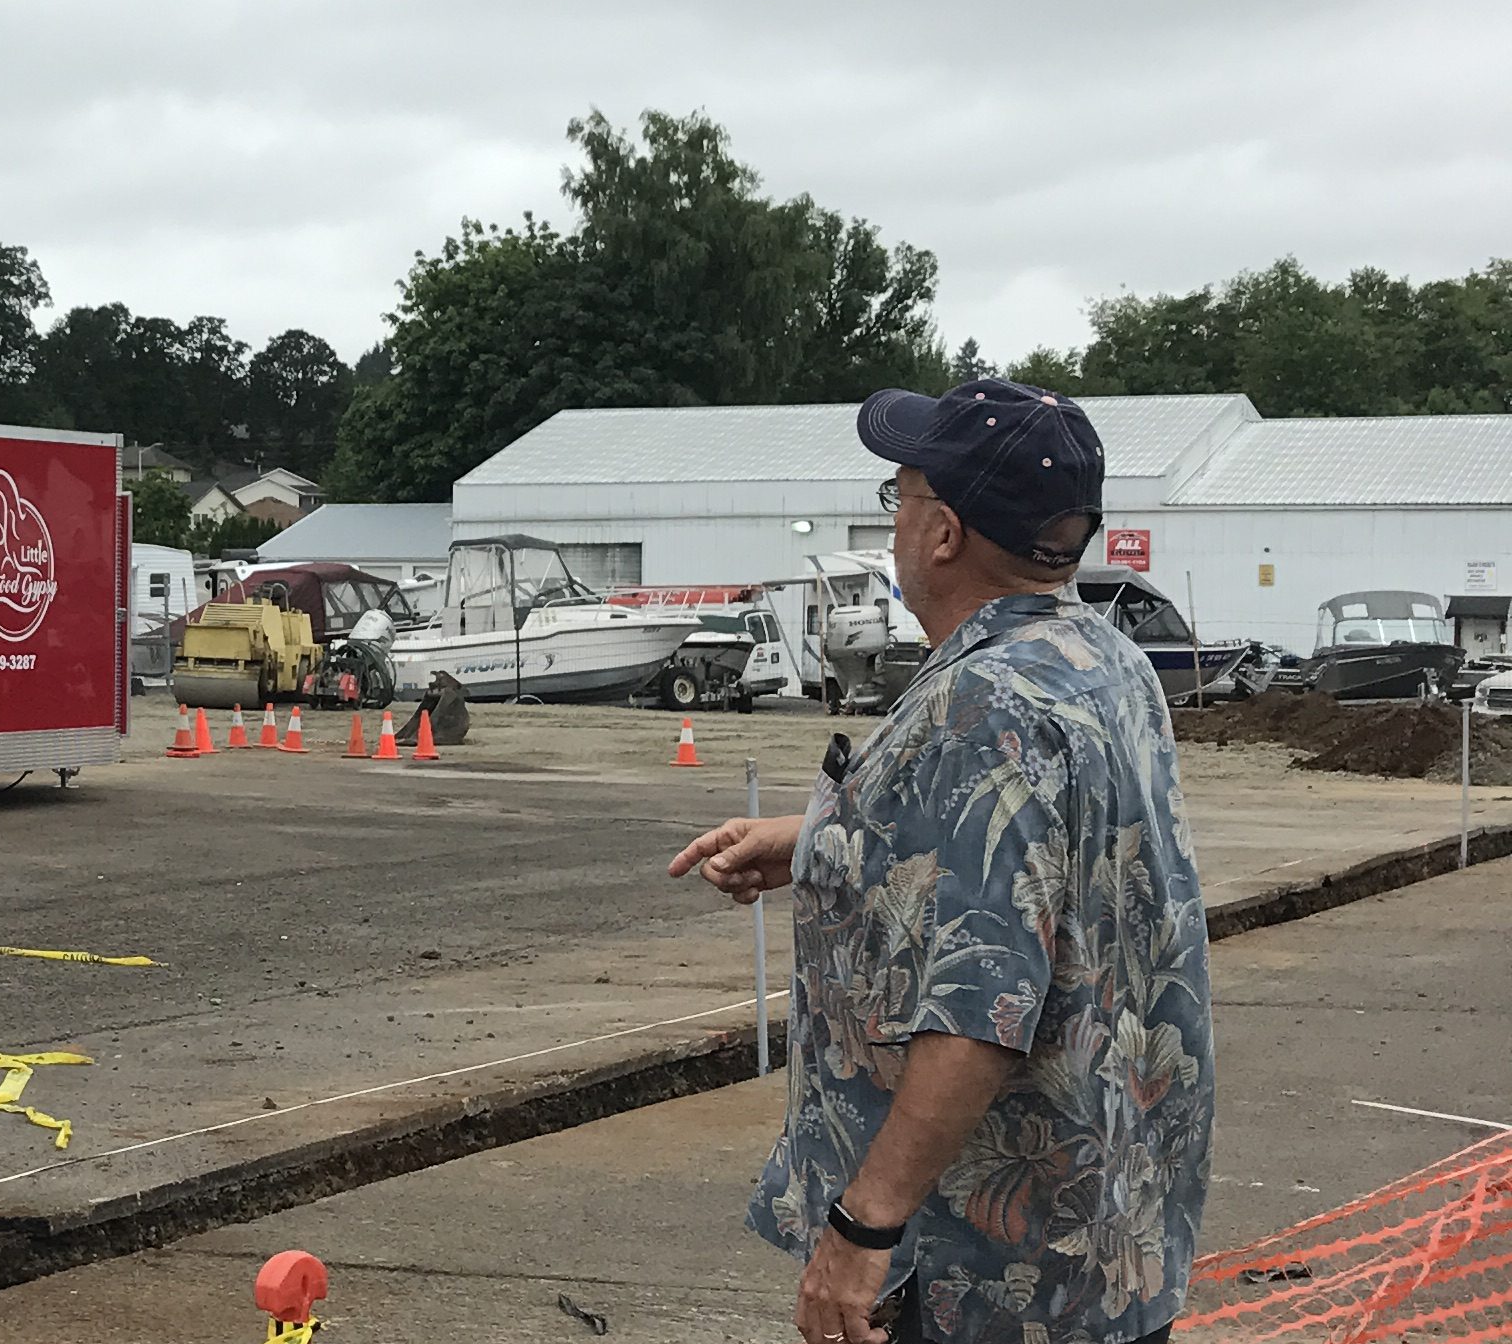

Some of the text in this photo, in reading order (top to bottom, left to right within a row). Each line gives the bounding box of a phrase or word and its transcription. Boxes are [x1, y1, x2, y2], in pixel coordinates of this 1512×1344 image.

[21, 540, 48, 565] Little
[21, 575, 58, 605] Gypsy
[849, 616, 884, 627] HONDA
